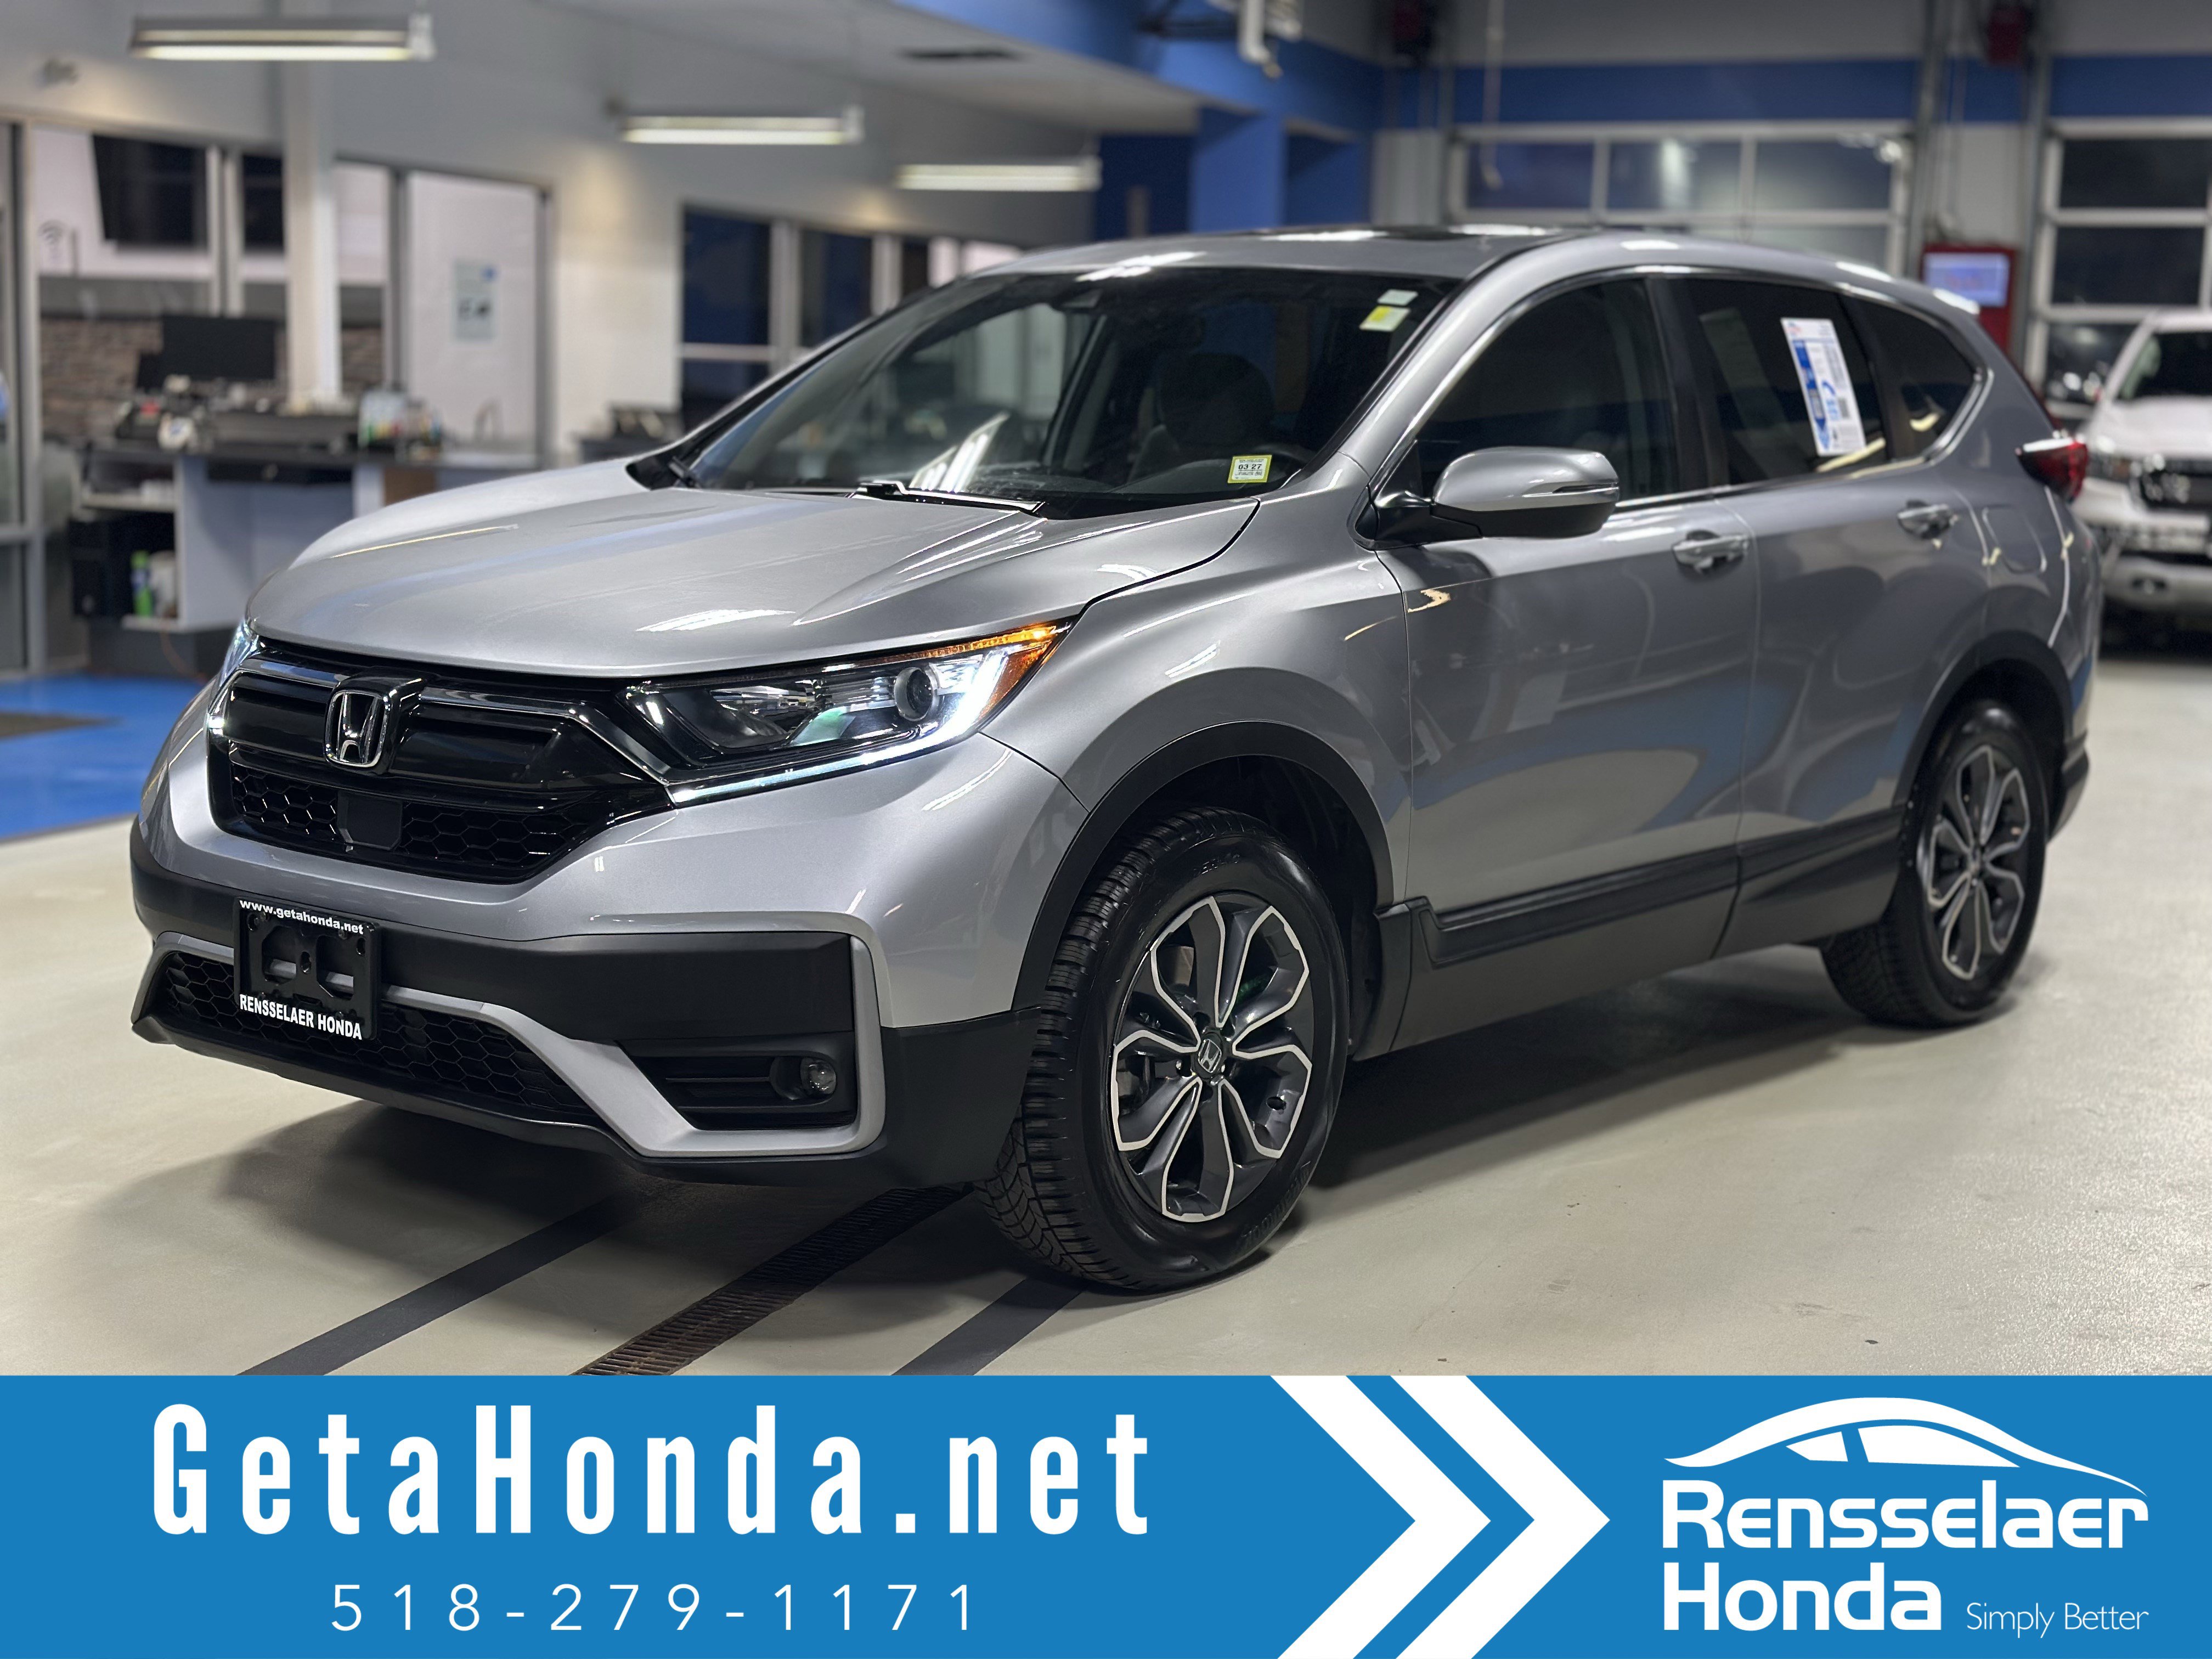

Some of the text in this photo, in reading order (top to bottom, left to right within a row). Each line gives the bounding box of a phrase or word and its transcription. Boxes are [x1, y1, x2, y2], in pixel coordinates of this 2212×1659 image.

[239, 900, 364, 935] www.getahonda.net
[239, 994, 363, 1040] RENSSELAER HONDA
